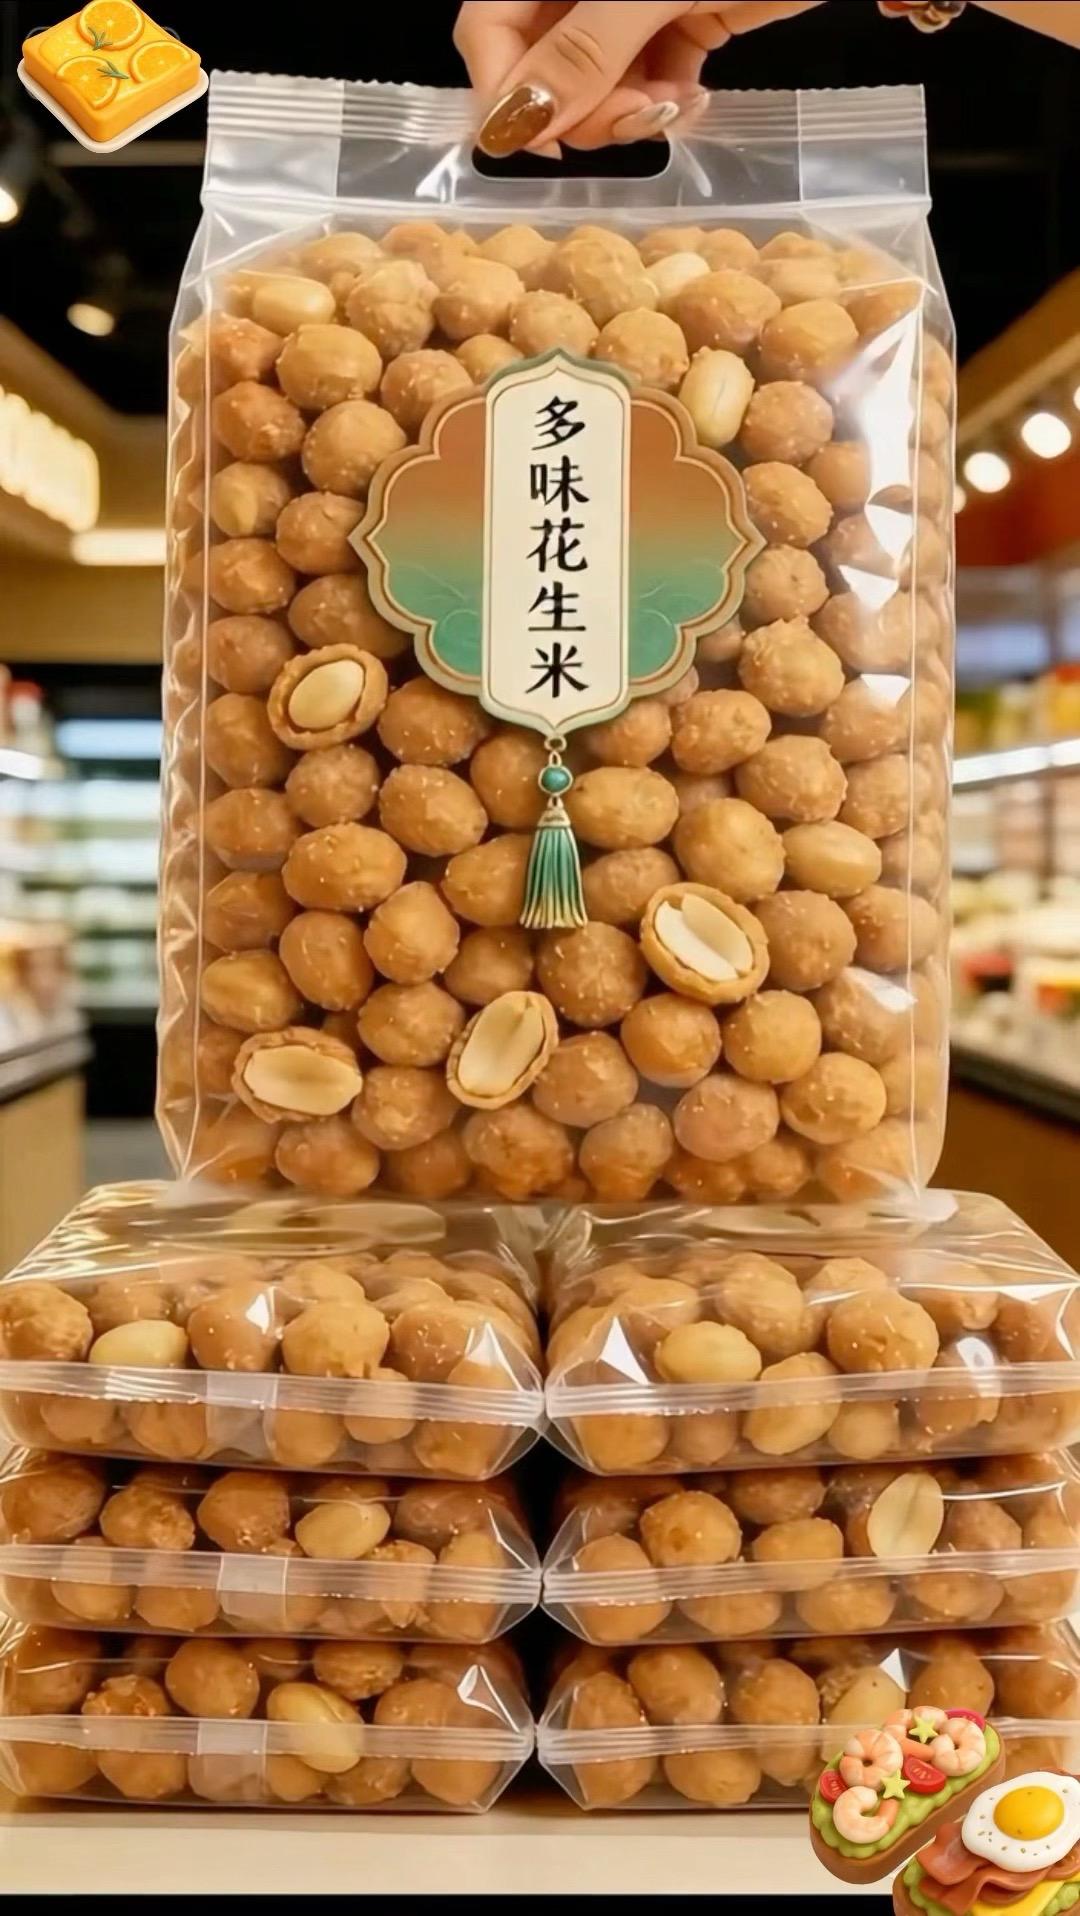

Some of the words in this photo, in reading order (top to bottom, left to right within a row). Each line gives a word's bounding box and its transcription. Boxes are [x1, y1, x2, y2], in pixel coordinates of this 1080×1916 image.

[525, 396, 589, 698] 多味花生米
